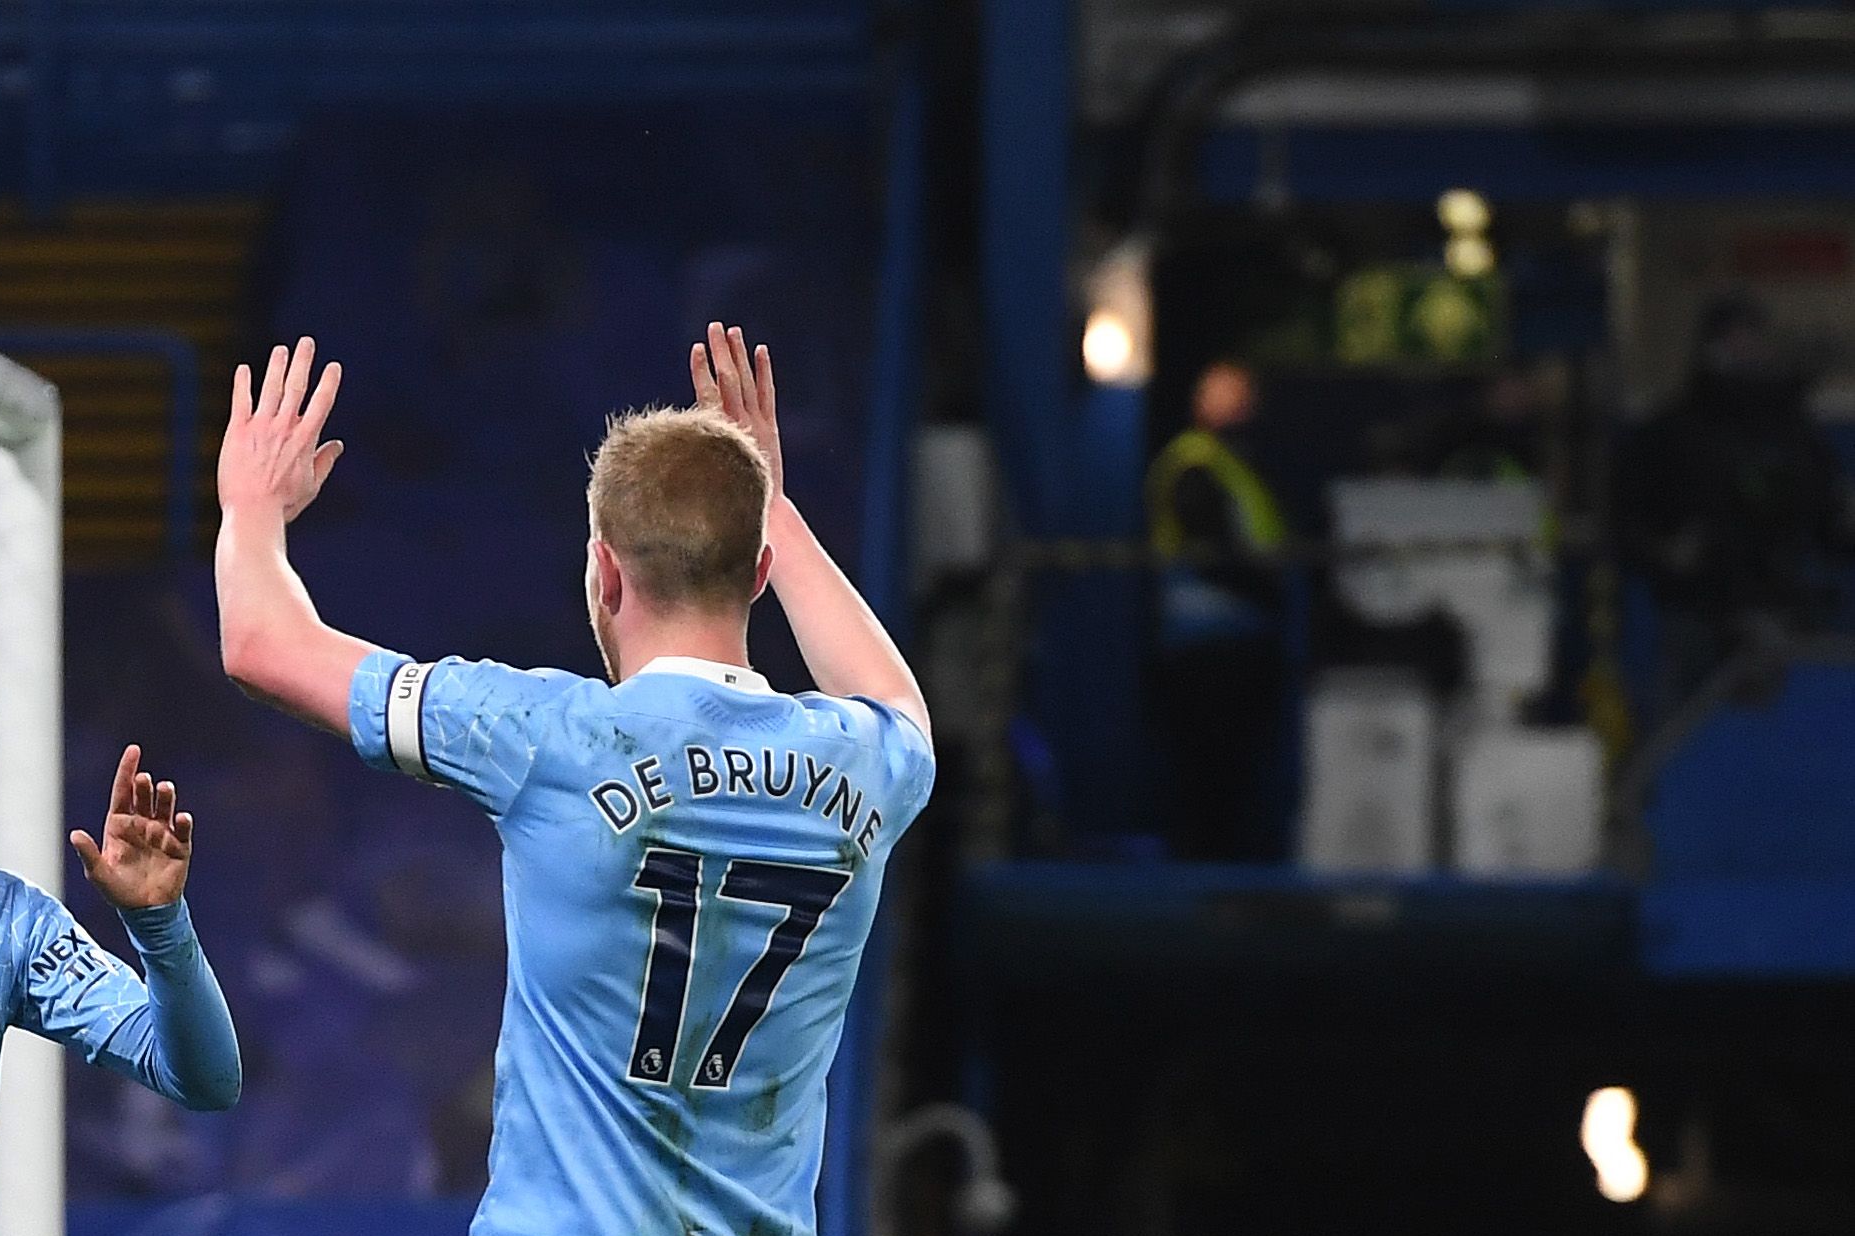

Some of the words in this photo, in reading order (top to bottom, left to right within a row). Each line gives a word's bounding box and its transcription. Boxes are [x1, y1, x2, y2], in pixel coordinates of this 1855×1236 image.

[397, 665, 420, 700] ain
[588, 755, 674, 834] DE
[685, 744, 883, 859] BRUYNE
[30, 927, 89, 982] NEX
[625, 847, 854, 1091] 17
